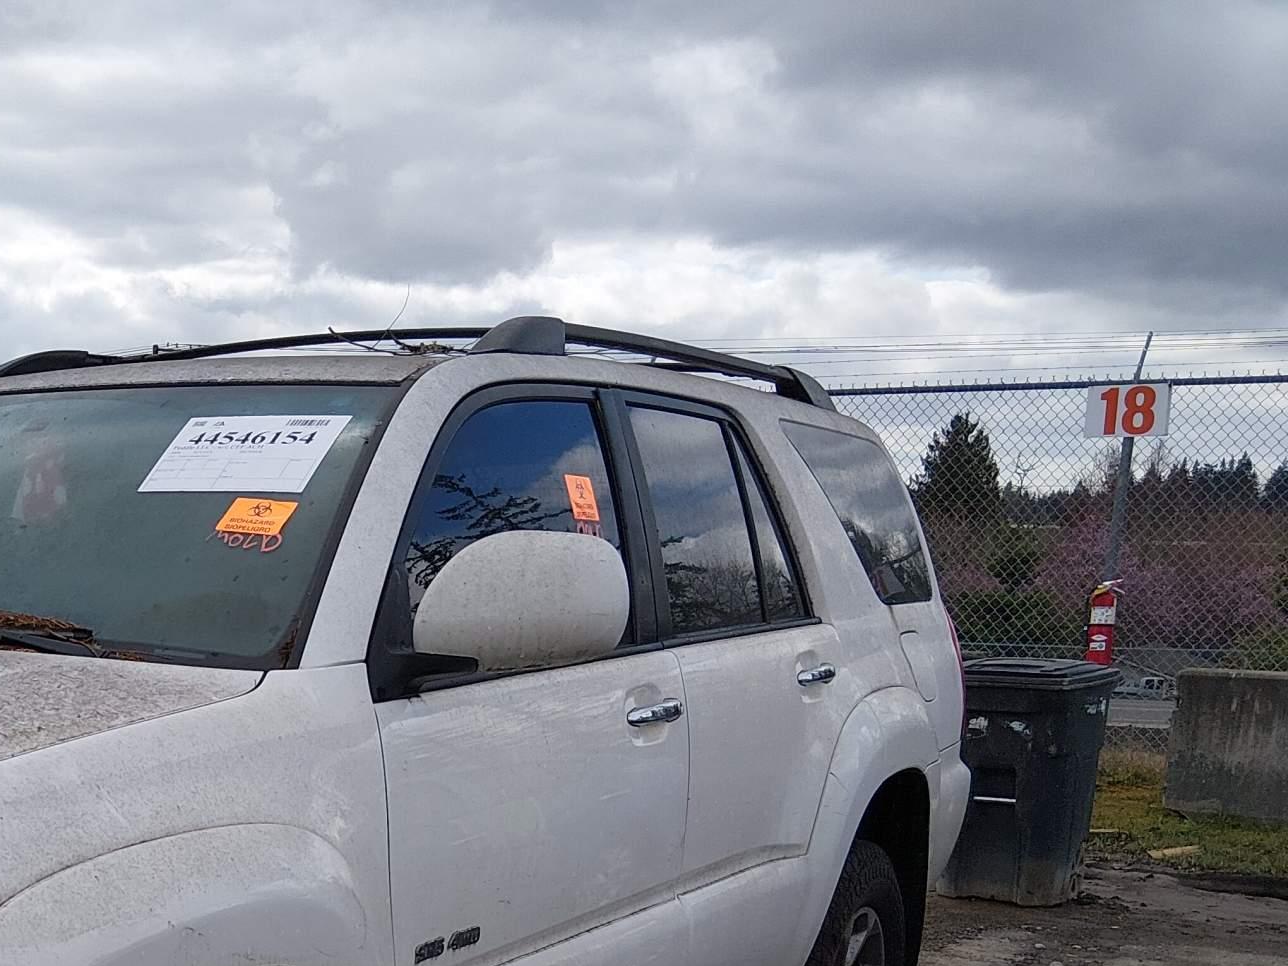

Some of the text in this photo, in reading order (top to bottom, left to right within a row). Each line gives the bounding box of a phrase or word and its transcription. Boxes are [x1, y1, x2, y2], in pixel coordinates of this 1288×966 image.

[1100, 385, 1156, 436] 18
[187, 430, 318, 445] 44546154
[223, 523, 271, 533] BIOPELIGRO
[229, 517, 276, 527] BIOHAZARD
